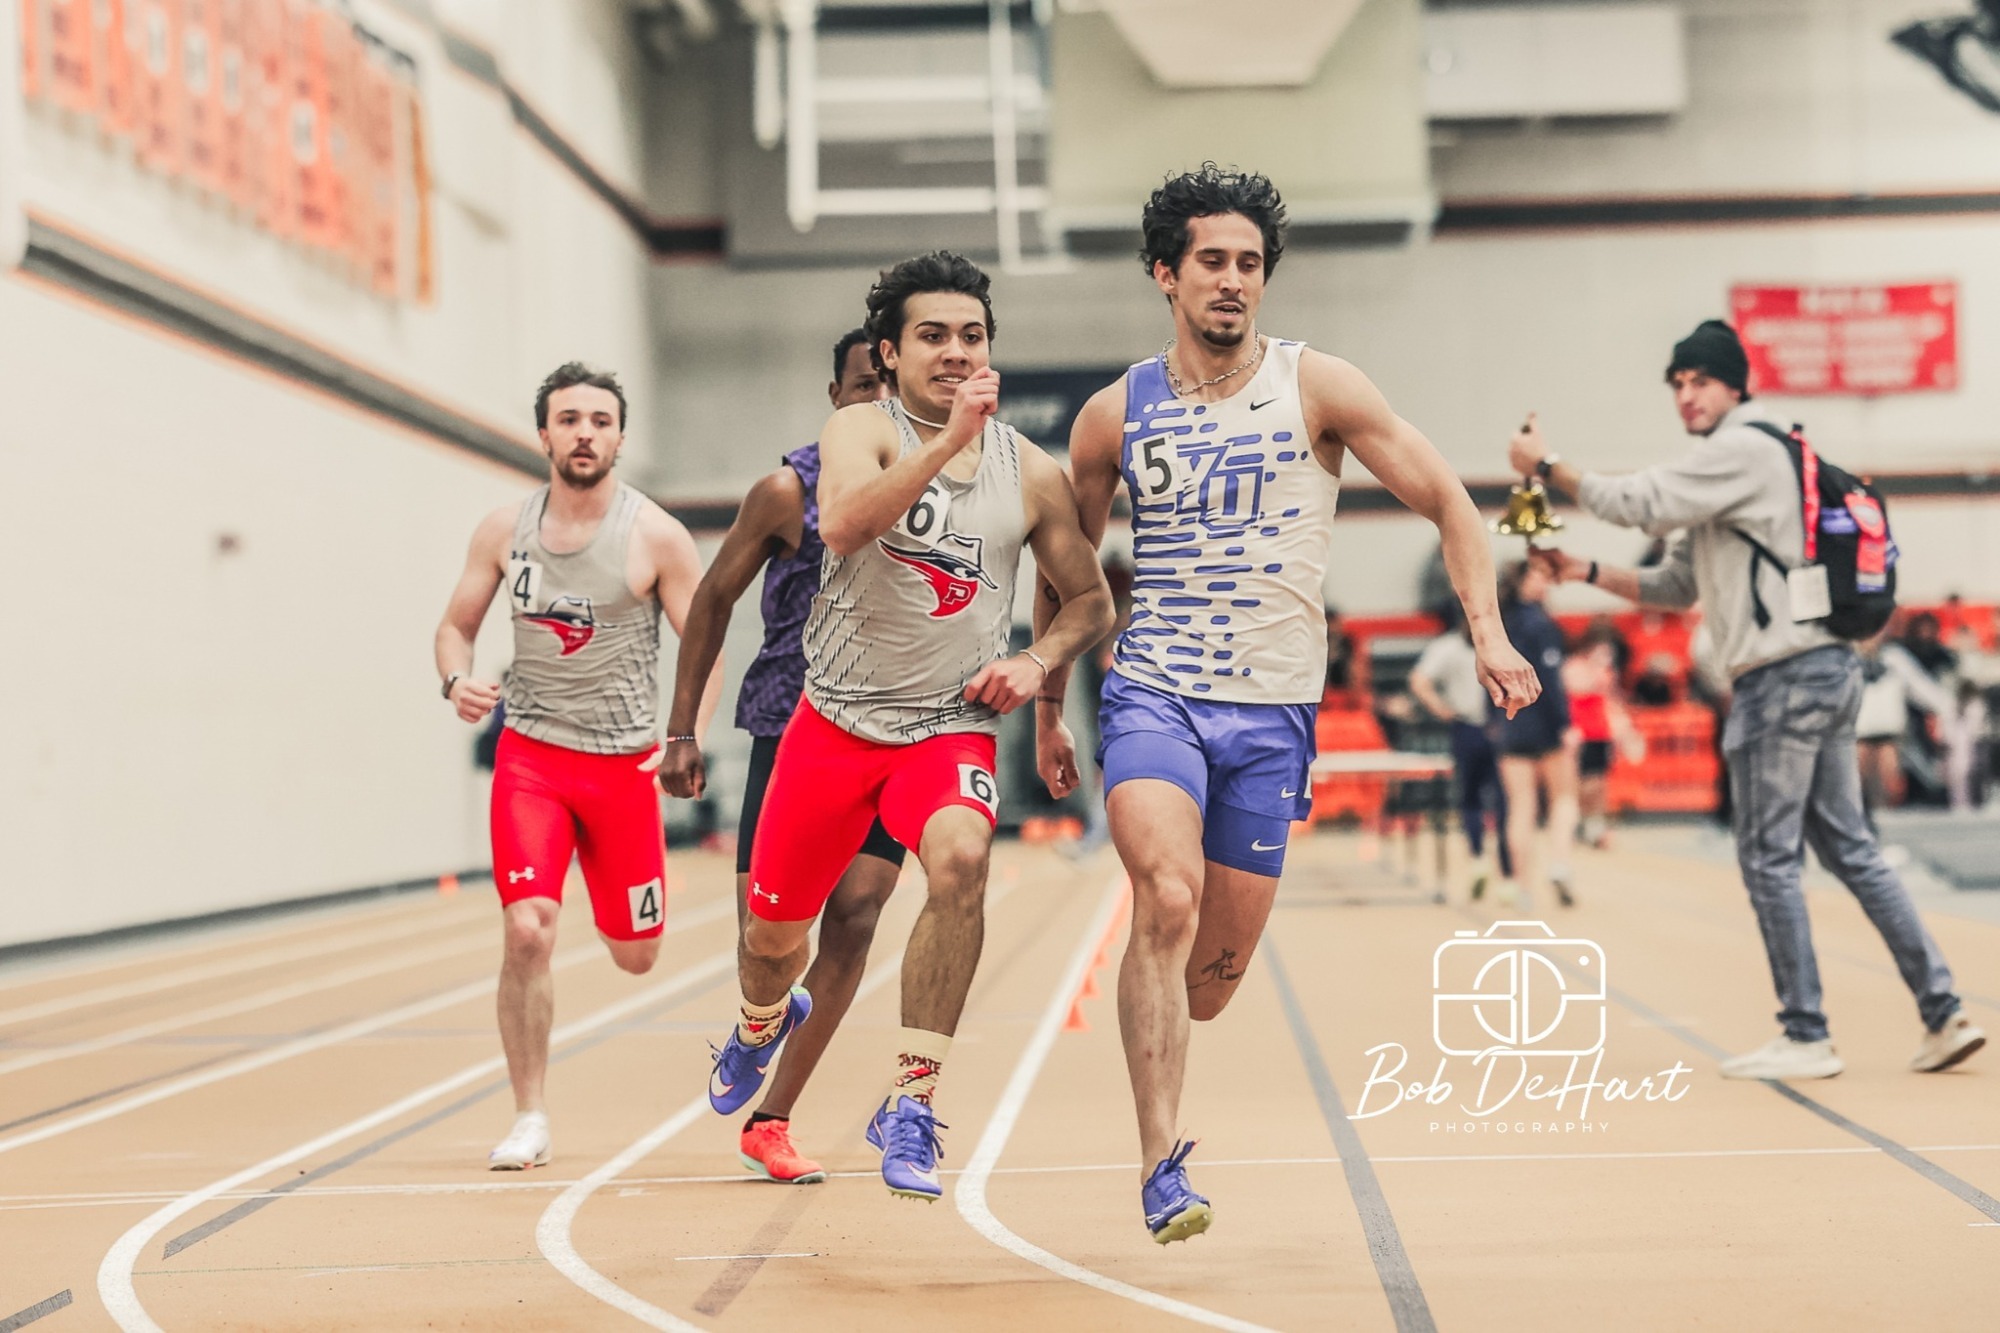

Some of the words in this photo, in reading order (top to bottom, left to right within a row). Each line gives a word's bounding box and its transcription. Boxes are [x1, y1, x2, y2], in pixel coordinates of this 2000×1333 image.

[1144, 437, 1172, 495] 5
[906, 484, 939, 537] 6
[513, 566, 531, 608] 4
[942, 582, 972, 605] P
[970, 769, 992, 804] 6
[639, 886, 659, 924] 4
